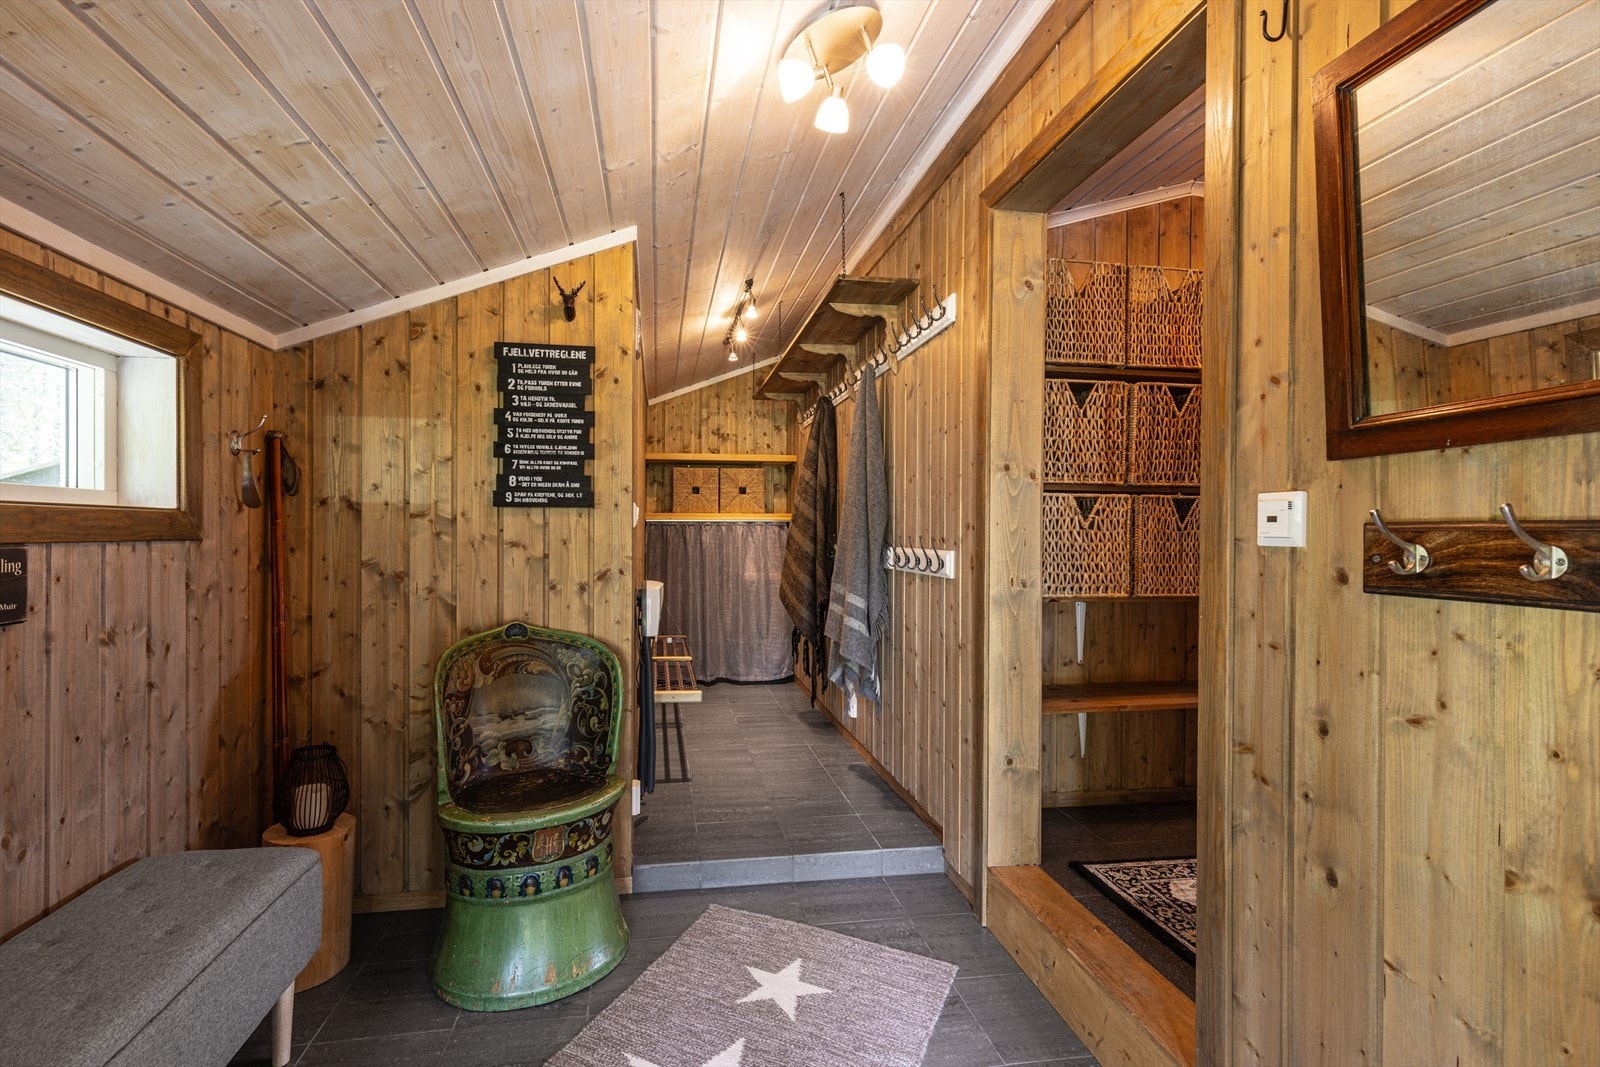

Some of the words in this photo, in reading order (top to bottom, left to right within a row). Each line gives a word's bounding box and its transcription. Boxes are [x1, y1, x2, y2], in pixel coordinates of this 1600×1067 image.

[503, 347, 586, 359] FJELLVETTREGLENE
[512, 363, 516, 373] 1
[508, 378, 515, 390] 2
[512, 395, 519, 406] 3
[505, 411, 512, 421] 4
[507, 428, 514, 438] 5
[504, 444, 511, 454] 6
[512, 460, 518, 469] 7
[509, 475, 516, 486] 8
[505, 492, 512, 502] 9
